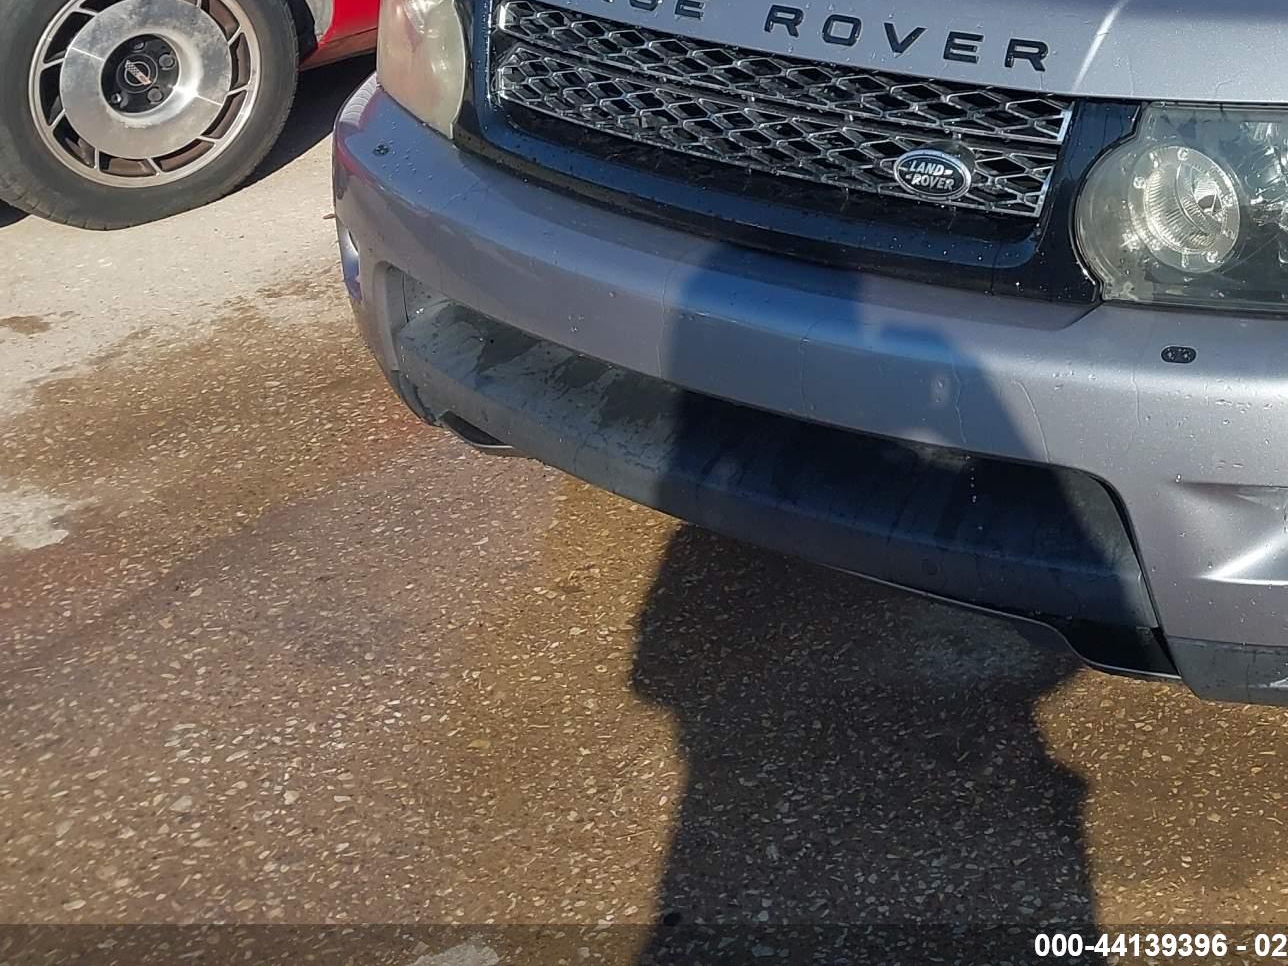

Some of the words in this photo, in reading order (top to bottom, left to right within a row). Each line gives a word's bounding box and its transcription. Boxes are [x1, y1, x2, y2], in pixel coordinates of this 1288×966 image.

[763, 4, 1050, 72] ROVER
[909, 160, 945, 176] LAND
[911, 174, 955, 191] ROVER
